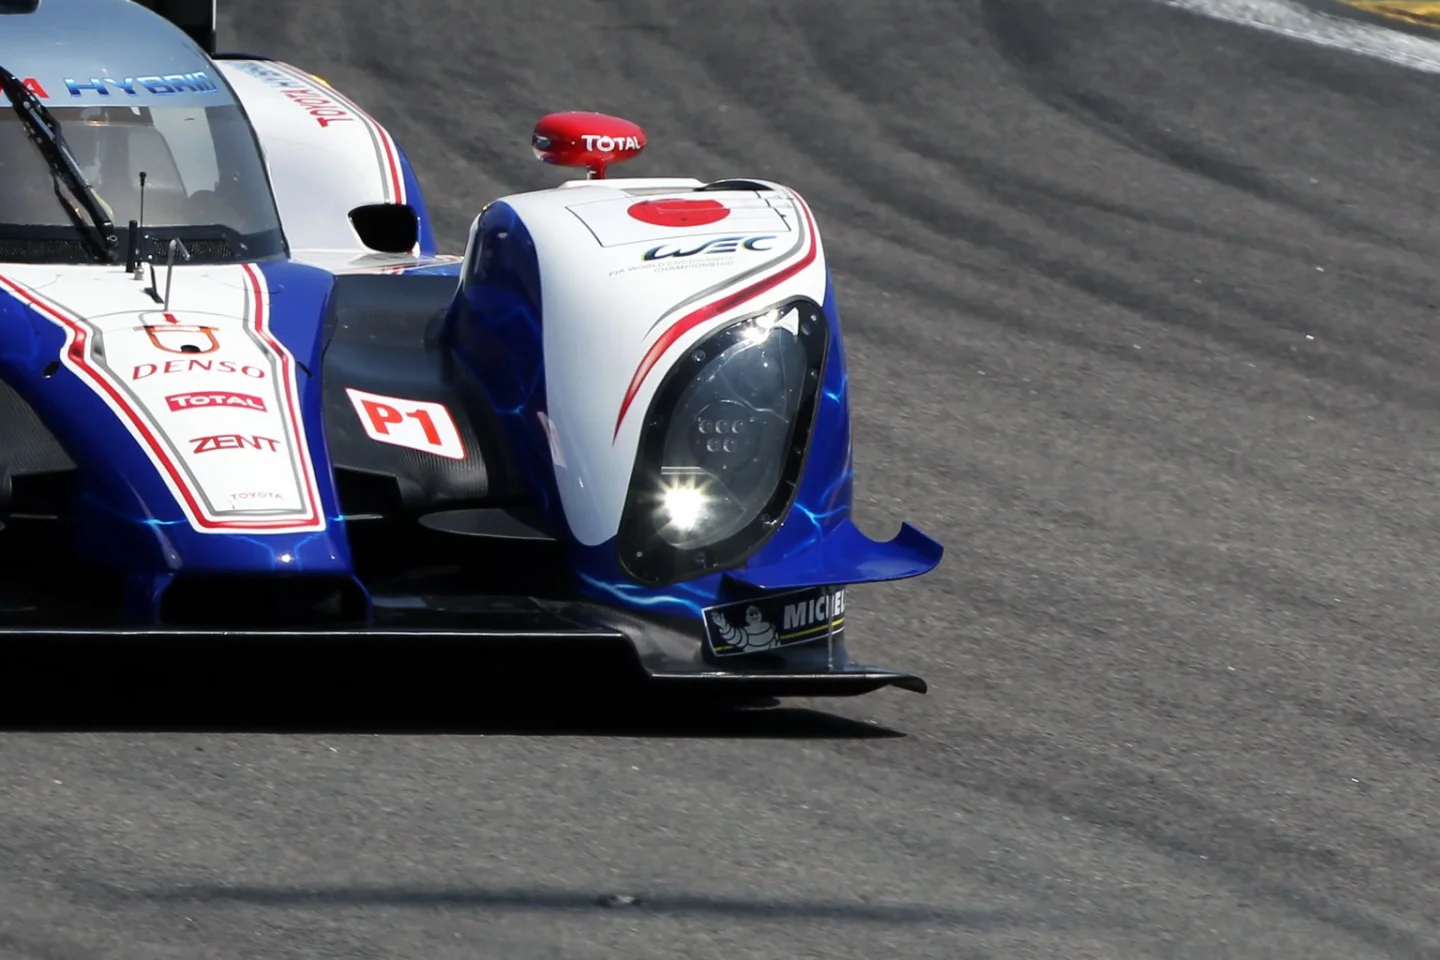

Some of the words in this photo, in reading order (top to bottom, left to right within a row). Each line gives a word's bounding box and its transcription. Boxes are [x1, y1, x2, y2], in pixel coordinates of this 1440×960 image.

[63, 71, 217, 99] HYBRID
[580, 134, 641, 152] TOTAL
[641, 235, 778, 261] WEC
[132, 359, 266, 381] DENSO
[170, 394, 265, 410] TOTAL
[360, 399, 443, 447] P1
[188, 434, 282, 455] ZENT
[230, 492, 284, 501] TOYOTA
[783, 589, 845, 630] MICHEL
